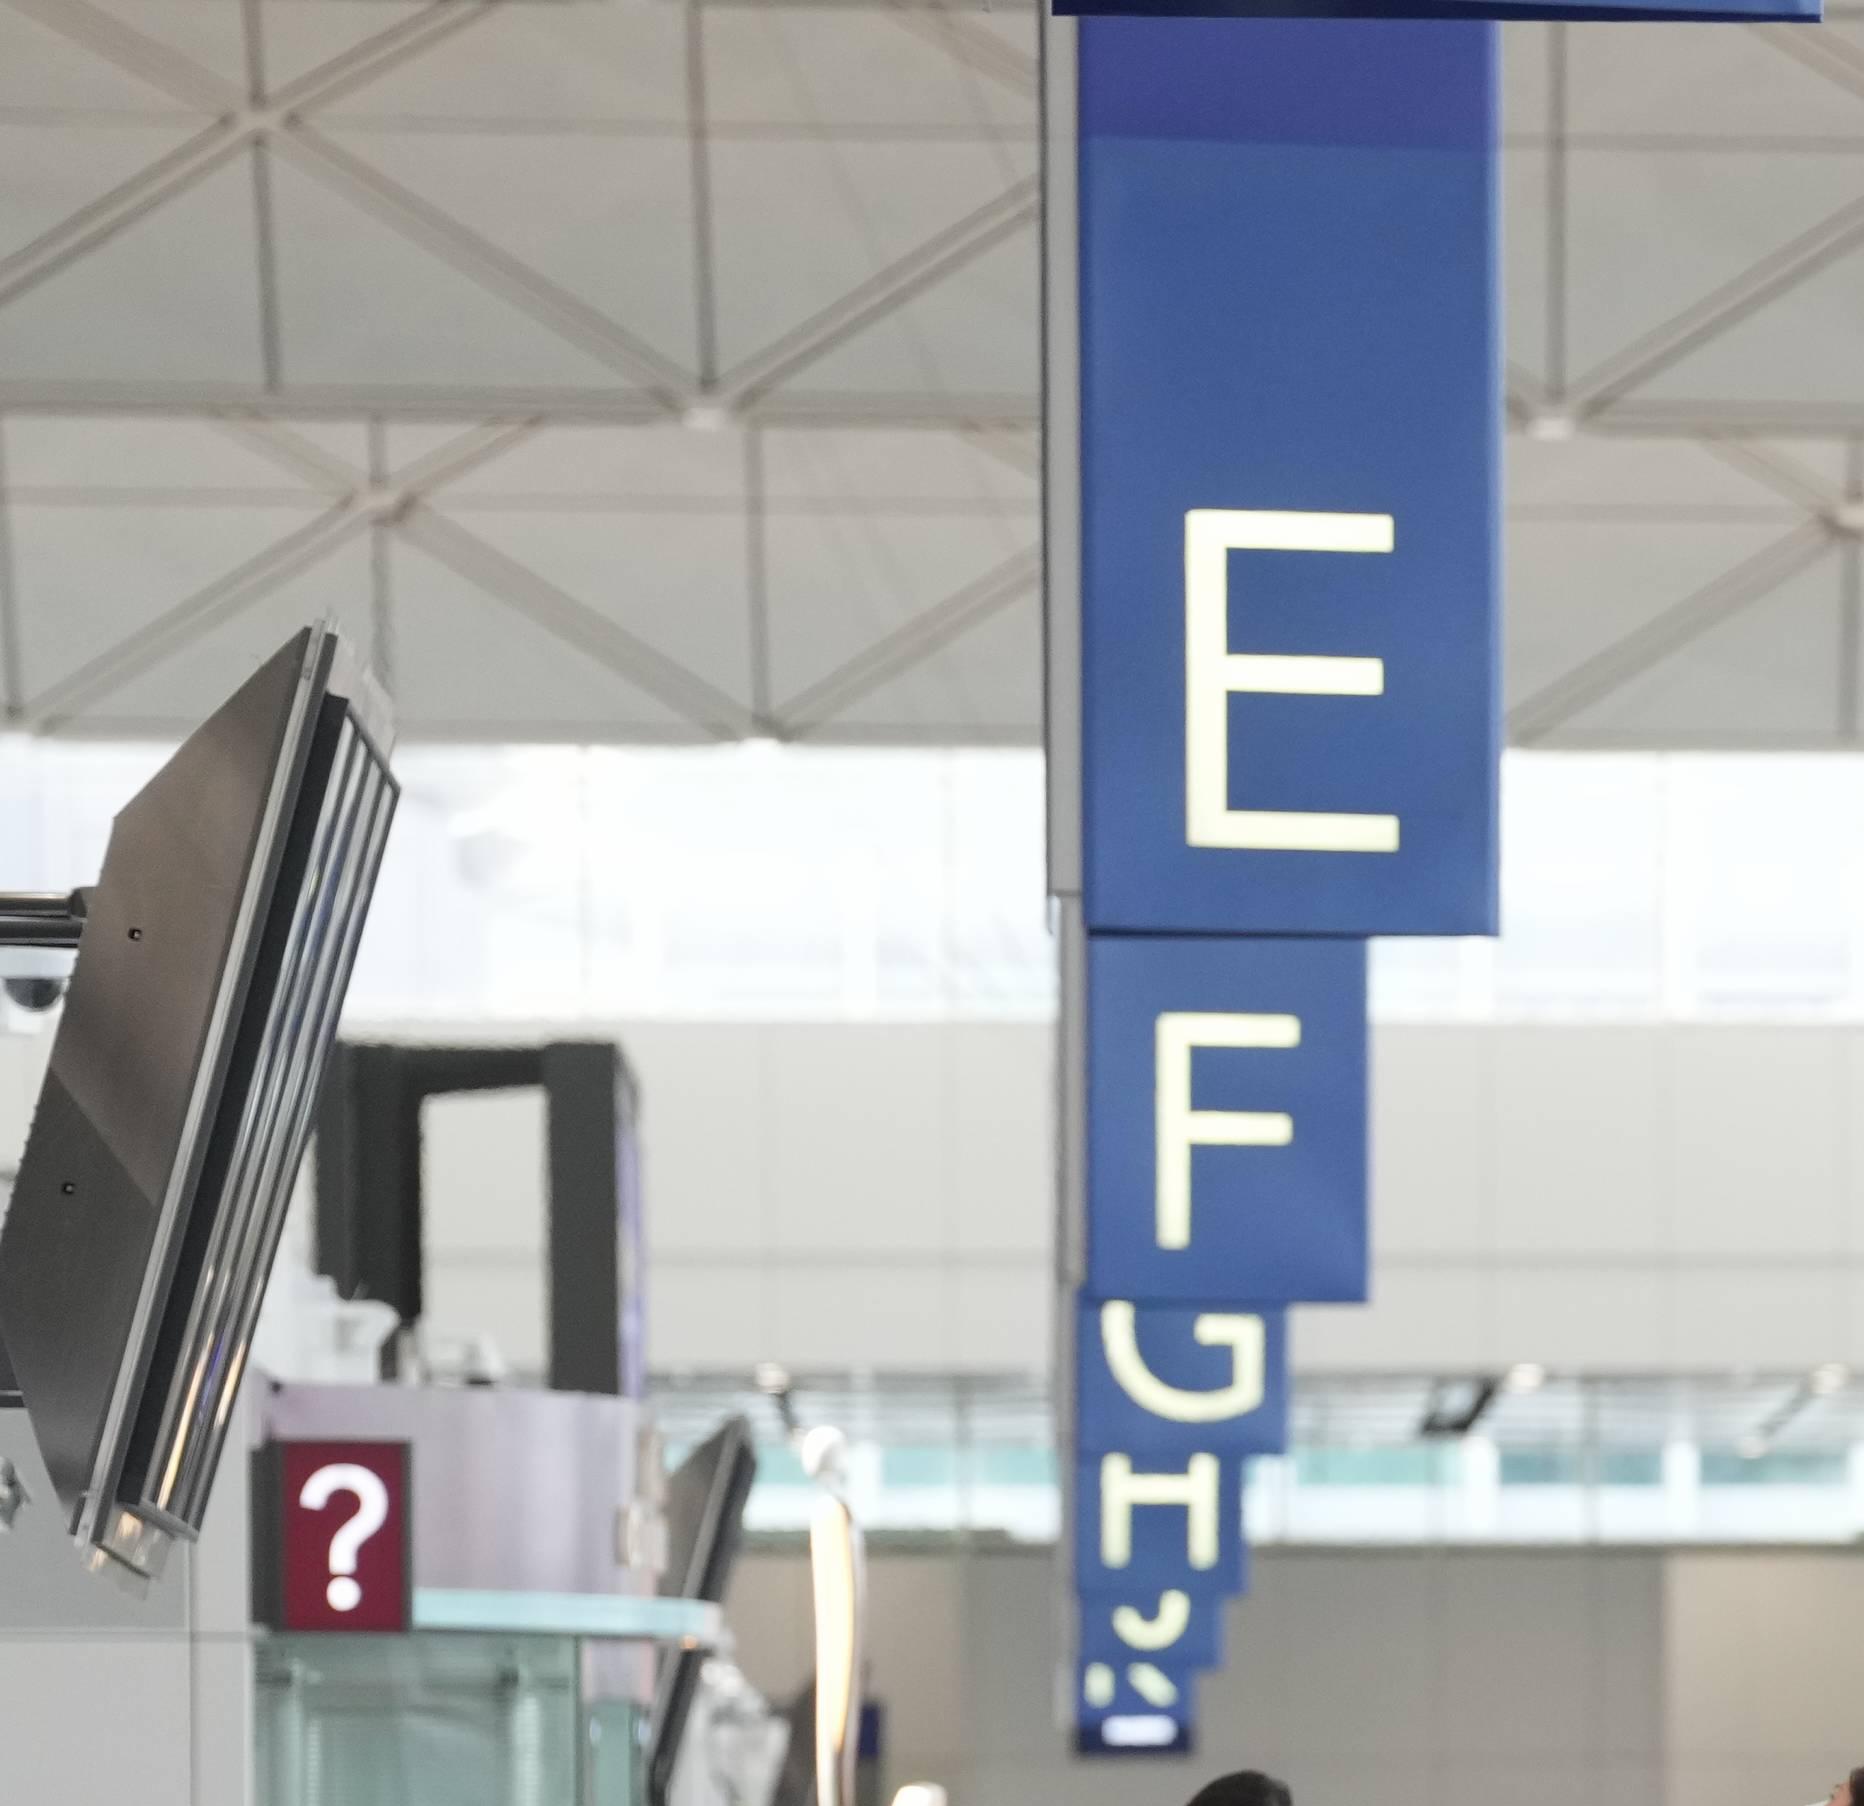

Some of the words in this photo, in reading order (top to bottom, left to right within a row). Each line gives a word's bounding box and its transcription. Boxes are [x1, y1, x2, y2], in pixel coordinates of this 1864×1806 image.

[1184, 508, 1400, 852] E
[1154, 1012, 1301, 1251] F
[1101, 1300, 1266, 1423] G
[300, 1463, 390, 1612] ?
[1101, 1452, 1220, 1570] H
